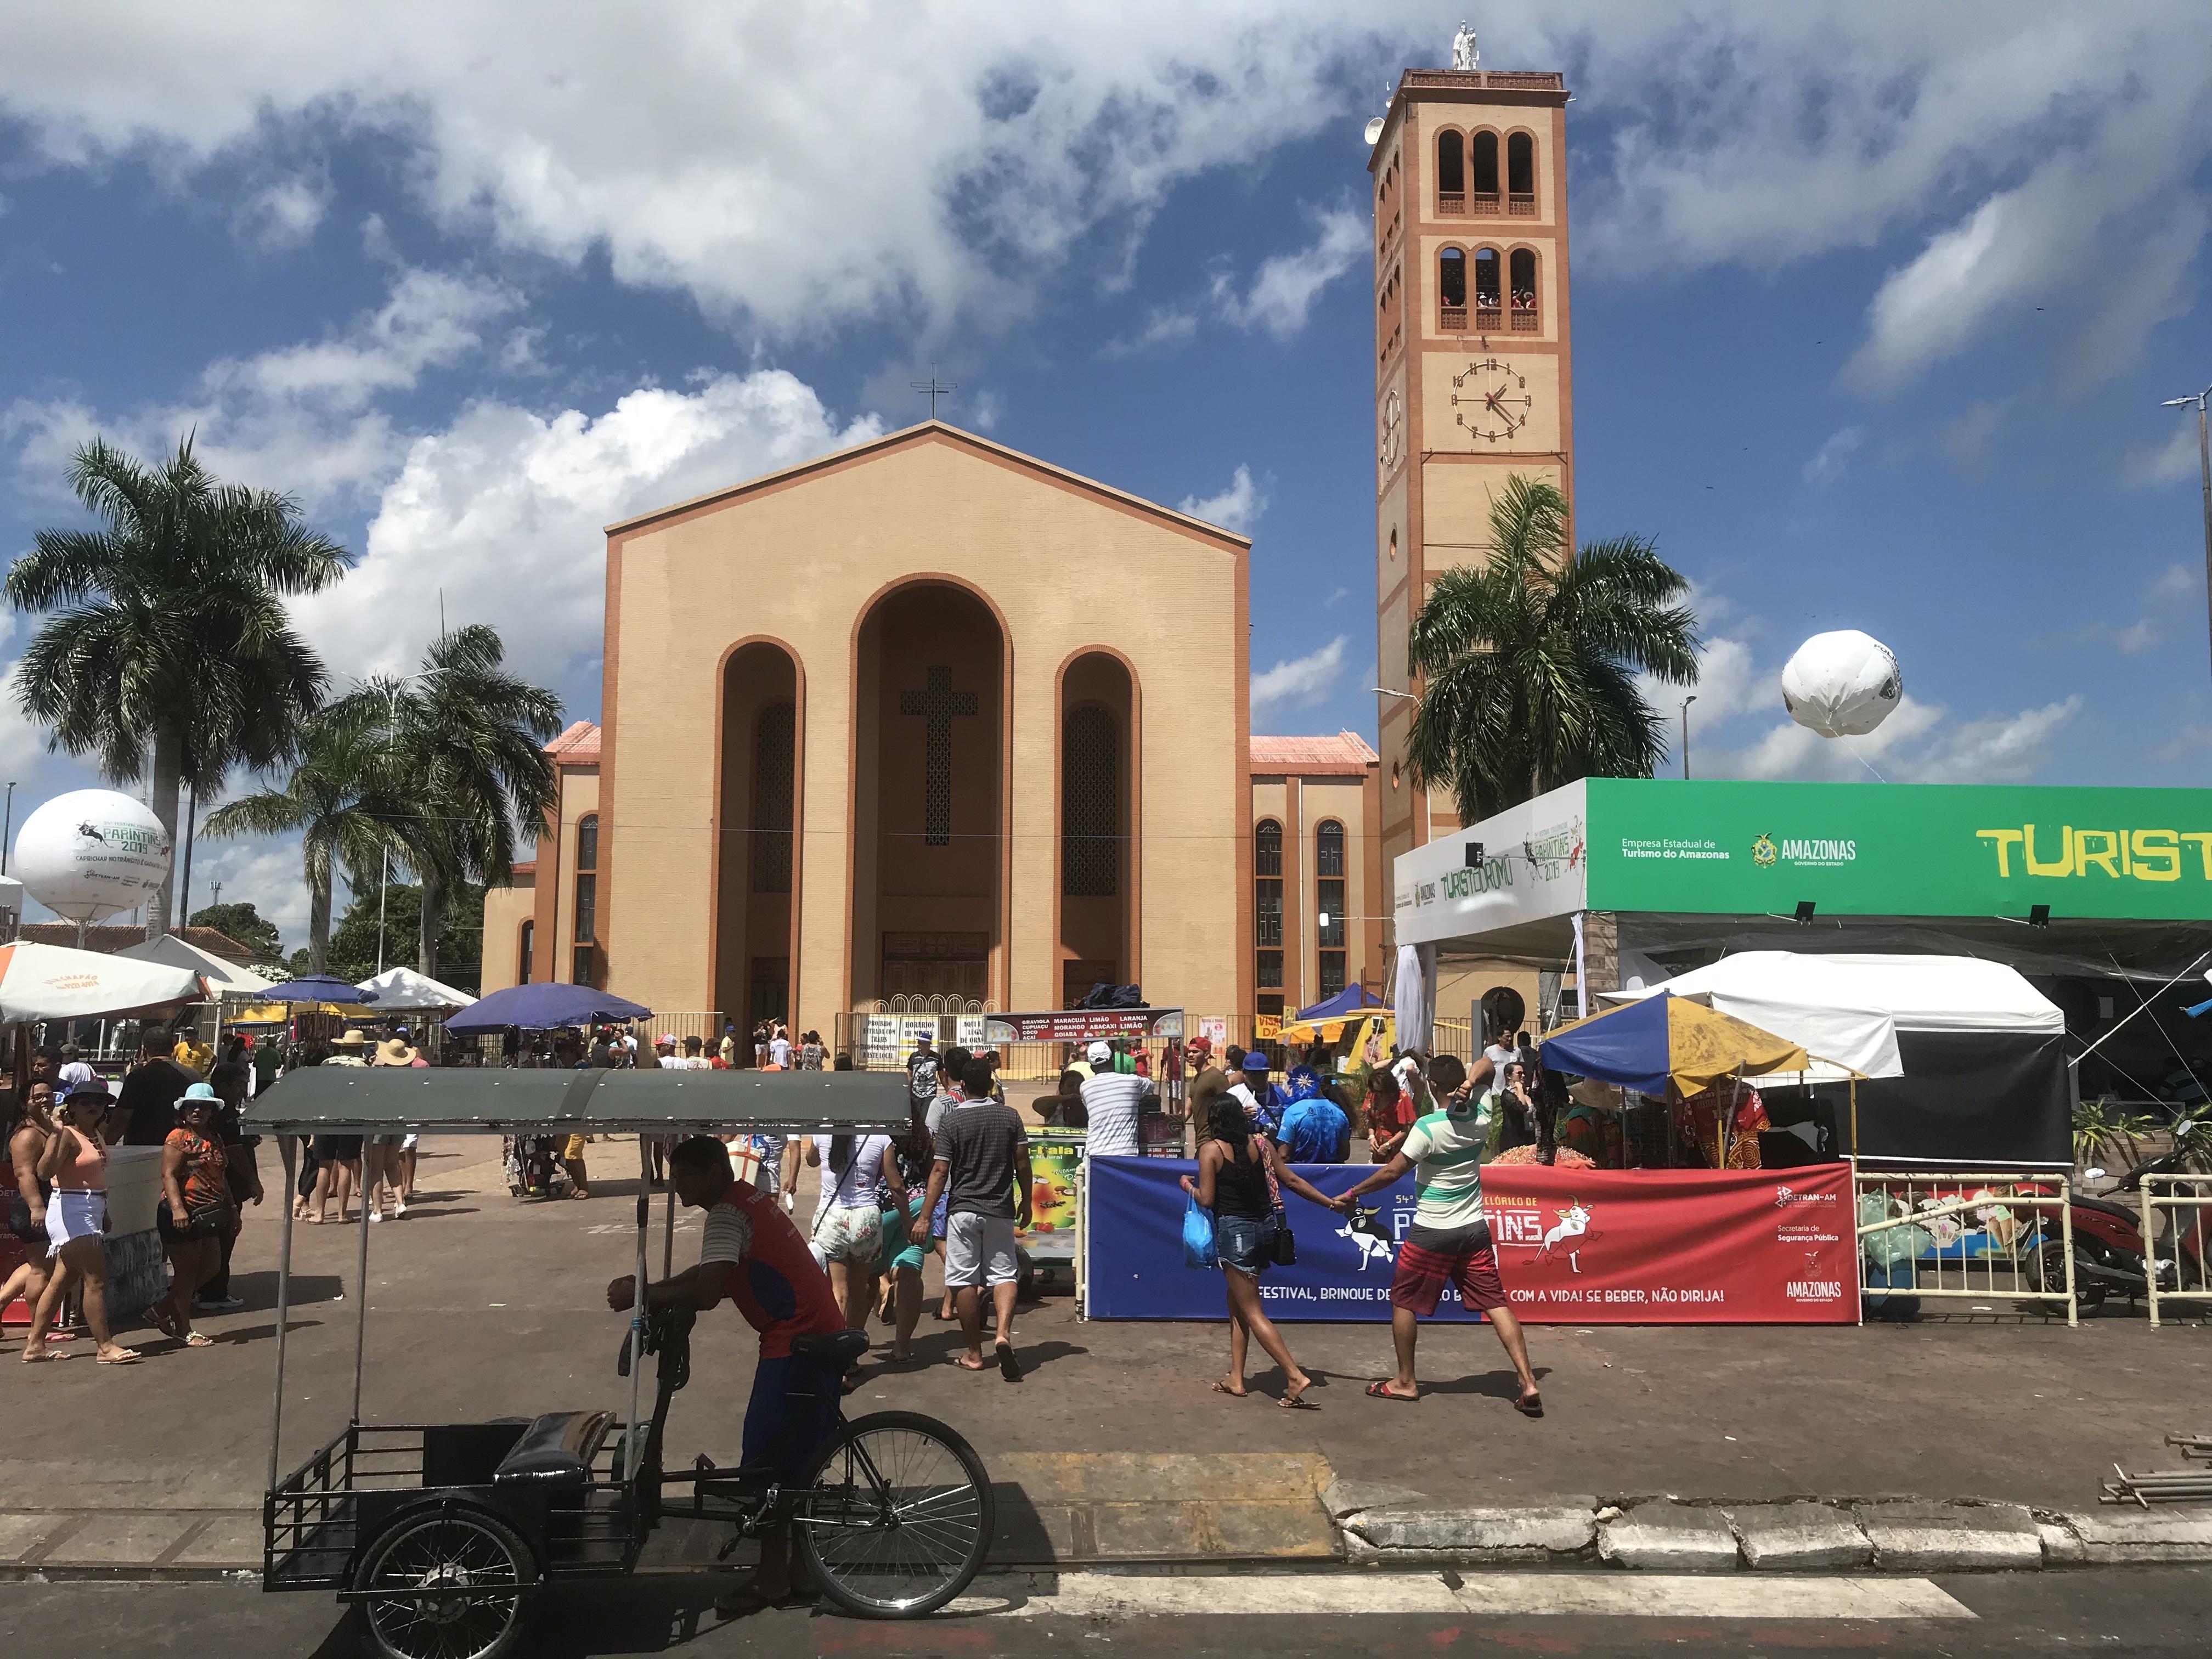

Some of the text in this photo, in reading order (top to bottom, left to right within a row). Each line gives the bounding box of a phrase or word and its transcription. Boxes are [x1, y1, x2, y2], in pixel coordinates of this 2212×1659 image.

[1470, 363, 1477, 375] 11
[1486, 358, 1497, 370] 12
[1453, 376, 1463, 387] 10
[1519, 376, 1525, 388] 2
[1525, 395, 1531, 407] 3
[1519, 414, 1525, 426] 4
[1471, 426, 1477, 438] 7
[1507, 427, 1513, 438] 5
[121, 841, 148, 854] 2019
[1622, 838, 1716, 849] Empresa Estadual de
[1782, 839, 1855, 860] AMAZONAS
[1622, 849, 1730, 859] Turismo do Amazonas
[1545, 860, 1559, 881] 2019
[1484, 1195, 1523, 1206] CLÓRICO
[1526, 1197, 1537, 1206] DE
[1778, 1234, 1813, 1243] Segurança
[1259, 1286, 1317, 1301] FESTIVAL,
[1321, 1288, 1374, 1300] BRINQUE
[1510, 1290, 1534, 1302] COM
[1538, 1290, 1547, 1302] A
[1550, 1290, 1582, 1302] VIDA!
[1587, 1290, 1602, 1302] SE
[1605, 1290, 1648, 1305] BEBER,
[1652, 1287, 1677, 1302] NÃO
[1681, 1289, 1724, 1302] DIRIJA!
[1787, 1282, 1841, 1297] AMAZONAS
